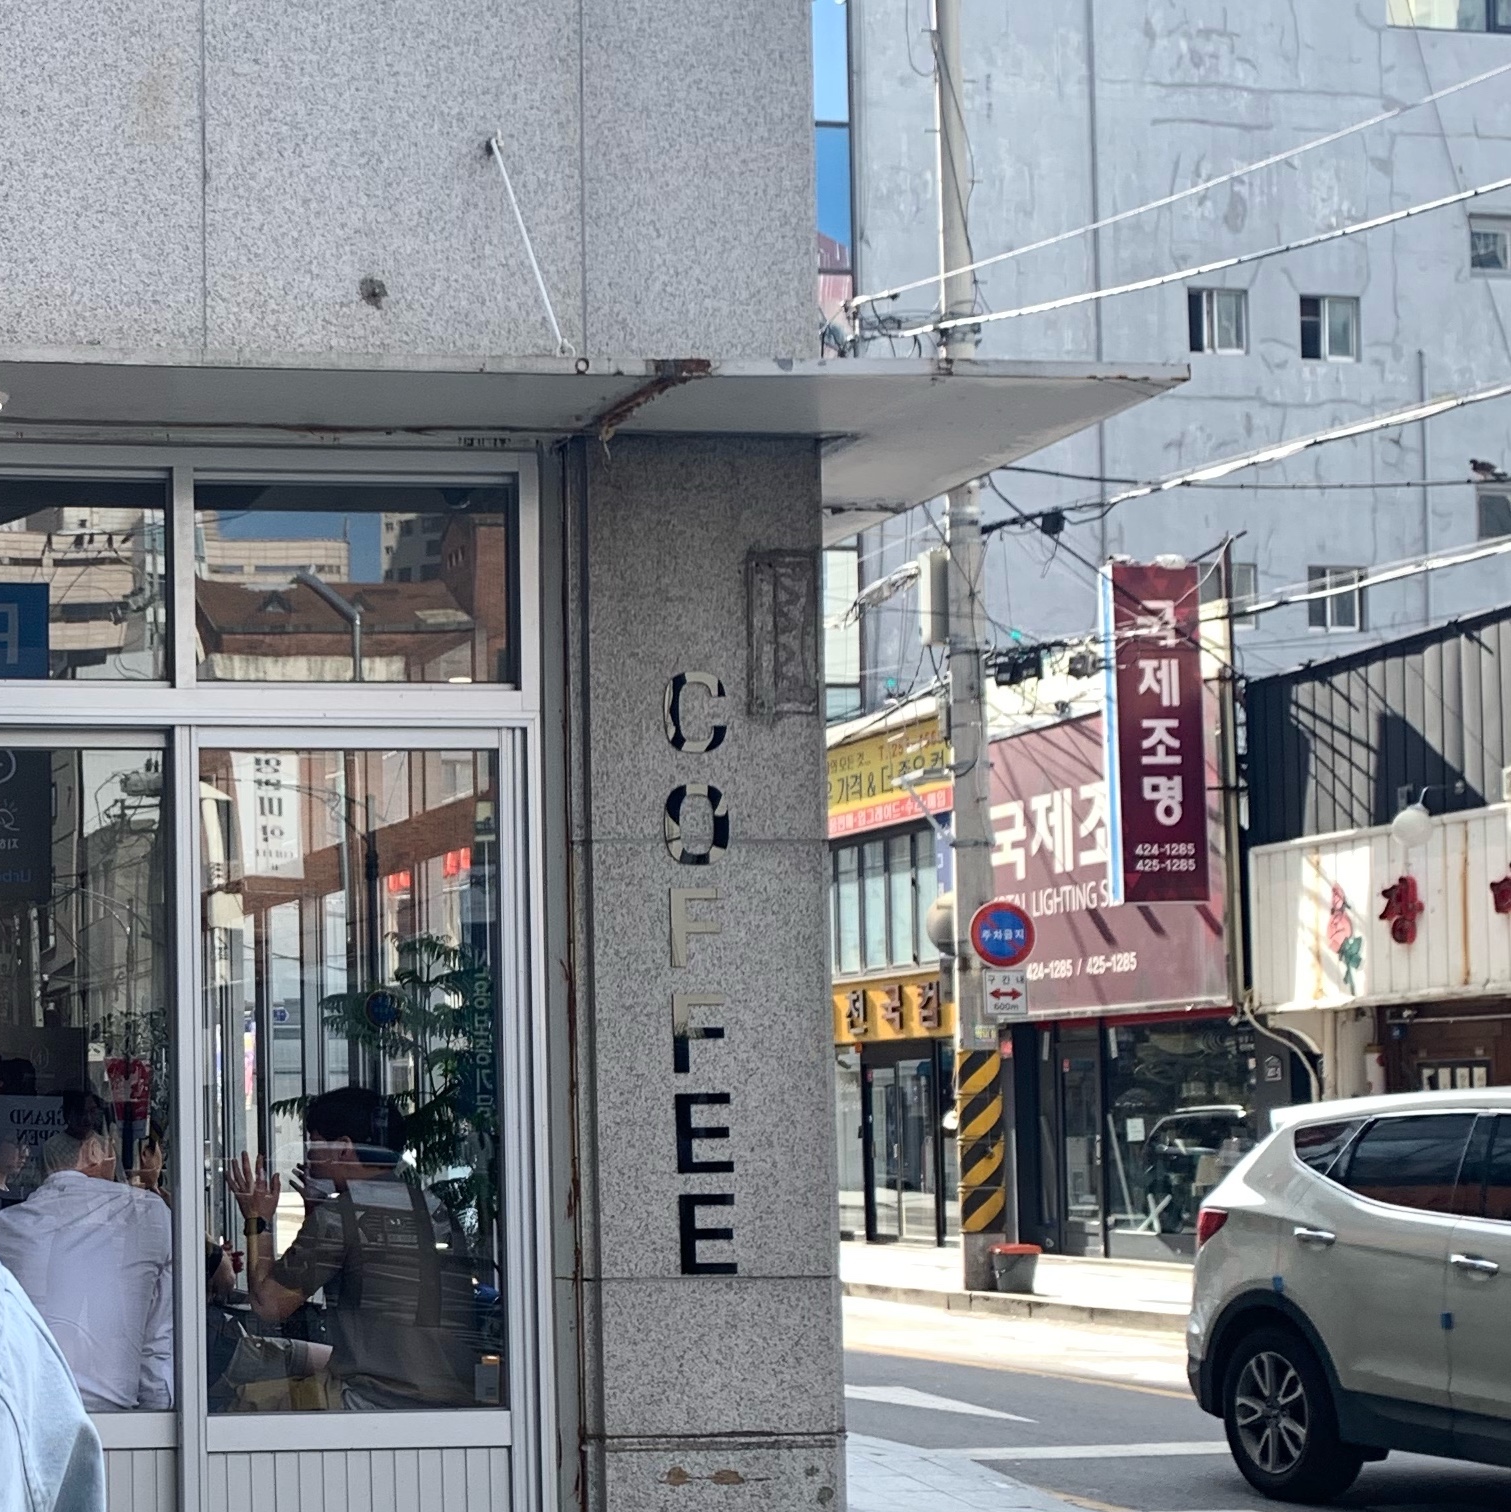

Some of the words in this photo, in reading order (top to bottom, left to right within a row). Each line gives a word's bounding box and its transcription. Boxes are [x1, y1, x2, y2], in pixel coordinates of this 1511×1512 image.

[1137, 599, 1184, 827] 국제조명
[1135, 842, 1195, 857] 424-1285
[1135, 858, 1196, 872] 425-1285
[1032, 881, 1098, 918] LIGHTING
[981, 928, 1025, 942] 주차금지
[663, 671, 738, 1275] COFFEE
[1026, 959, 1073, 981] 424-1285
[1085, 952, 1138, 976] 425-1285
